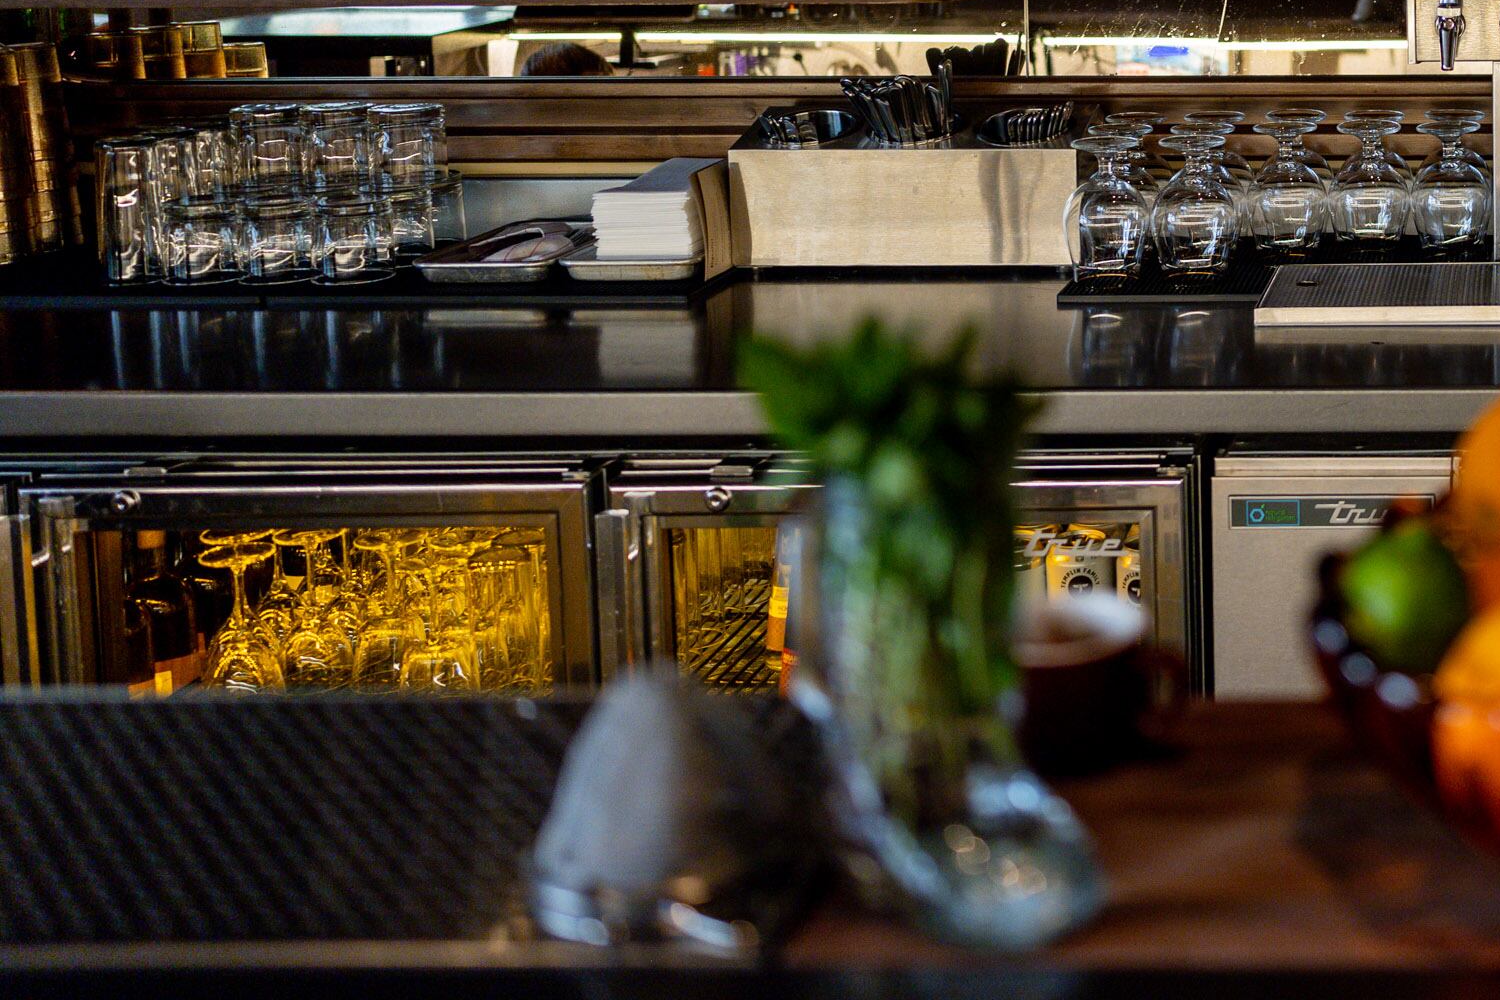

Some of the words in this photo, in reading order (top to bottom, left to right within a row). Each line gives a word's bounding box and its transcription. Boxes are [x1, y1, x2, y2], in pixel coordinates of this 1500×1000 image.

[1023, 529, 1130, 557] true
[1060, 568, 1081, 588] TEMPLIN
[1083, 567, 1100, 585] FAMILY
